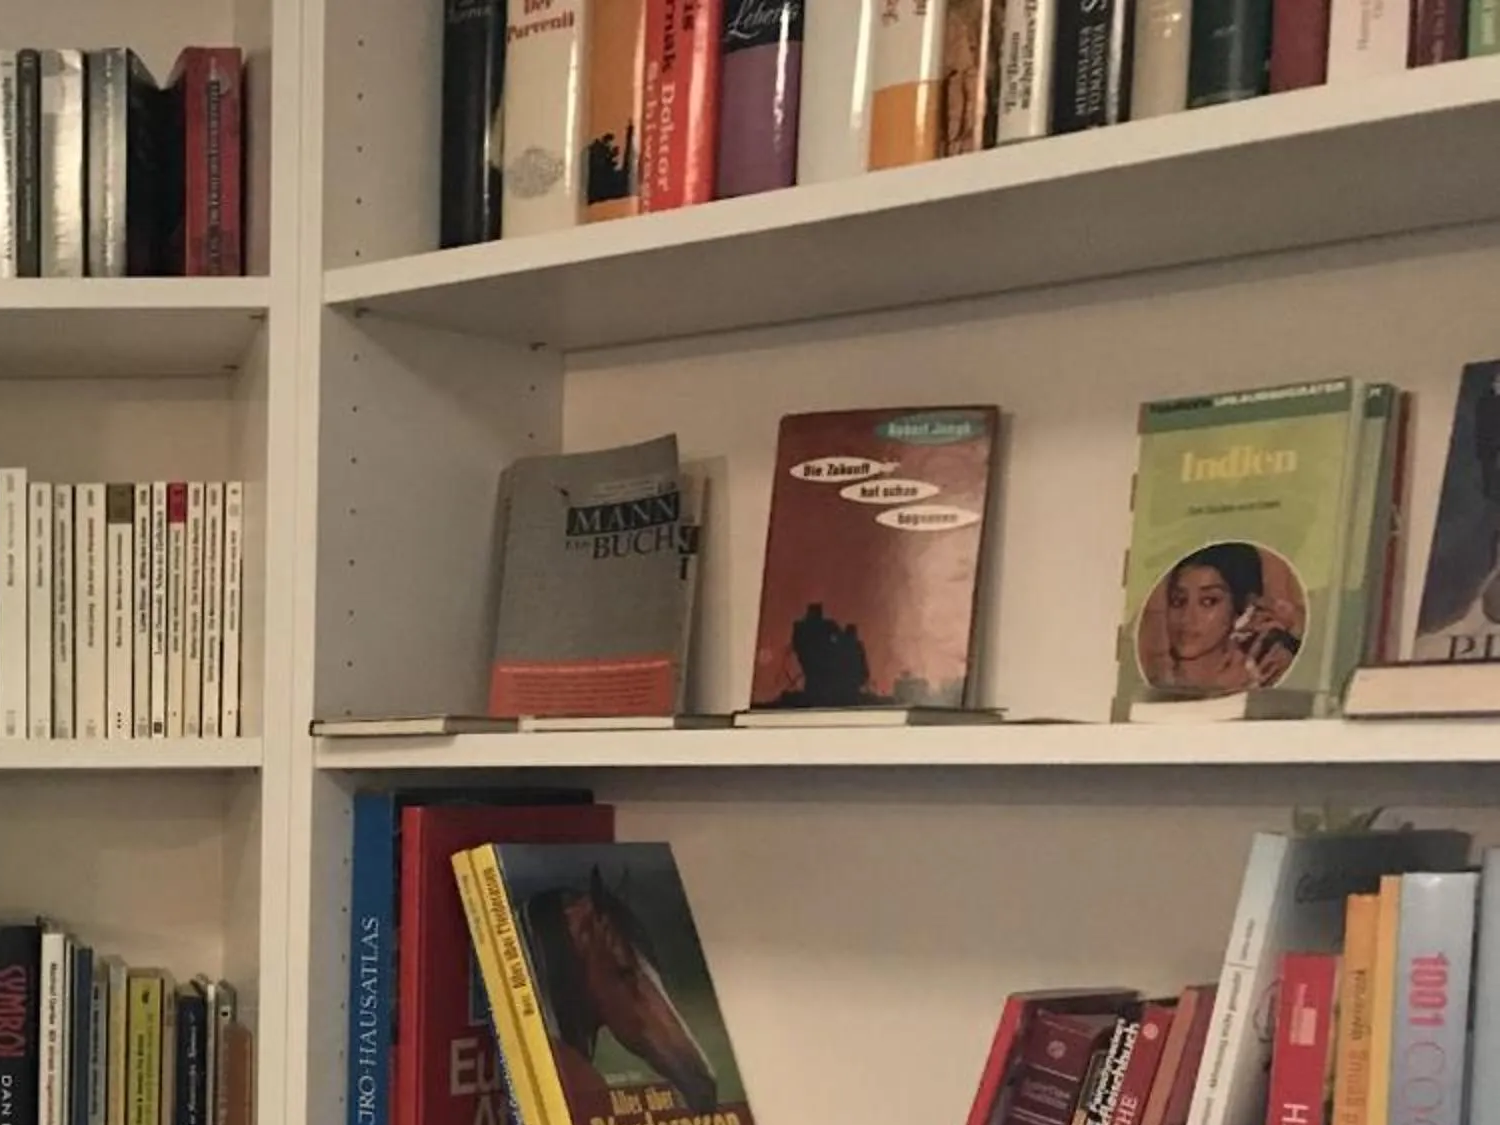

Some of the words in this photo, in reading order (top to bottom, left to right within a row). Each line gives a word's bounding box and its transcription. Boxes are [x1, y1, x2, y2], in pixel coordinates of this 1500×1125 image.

[656, 79, 676, 193] Doktor
[803, 463, 822, 478] Die
[1180, 446, 1298, 484] Indien
[573, 495, 678, 532] MANN
[592, 526, 677, 560] BUCH
[1410, 951, 1451, 1026] 1001
[0, 1074, 13, 1117] DAN
[609, 1088, 643, 1117] Alles
